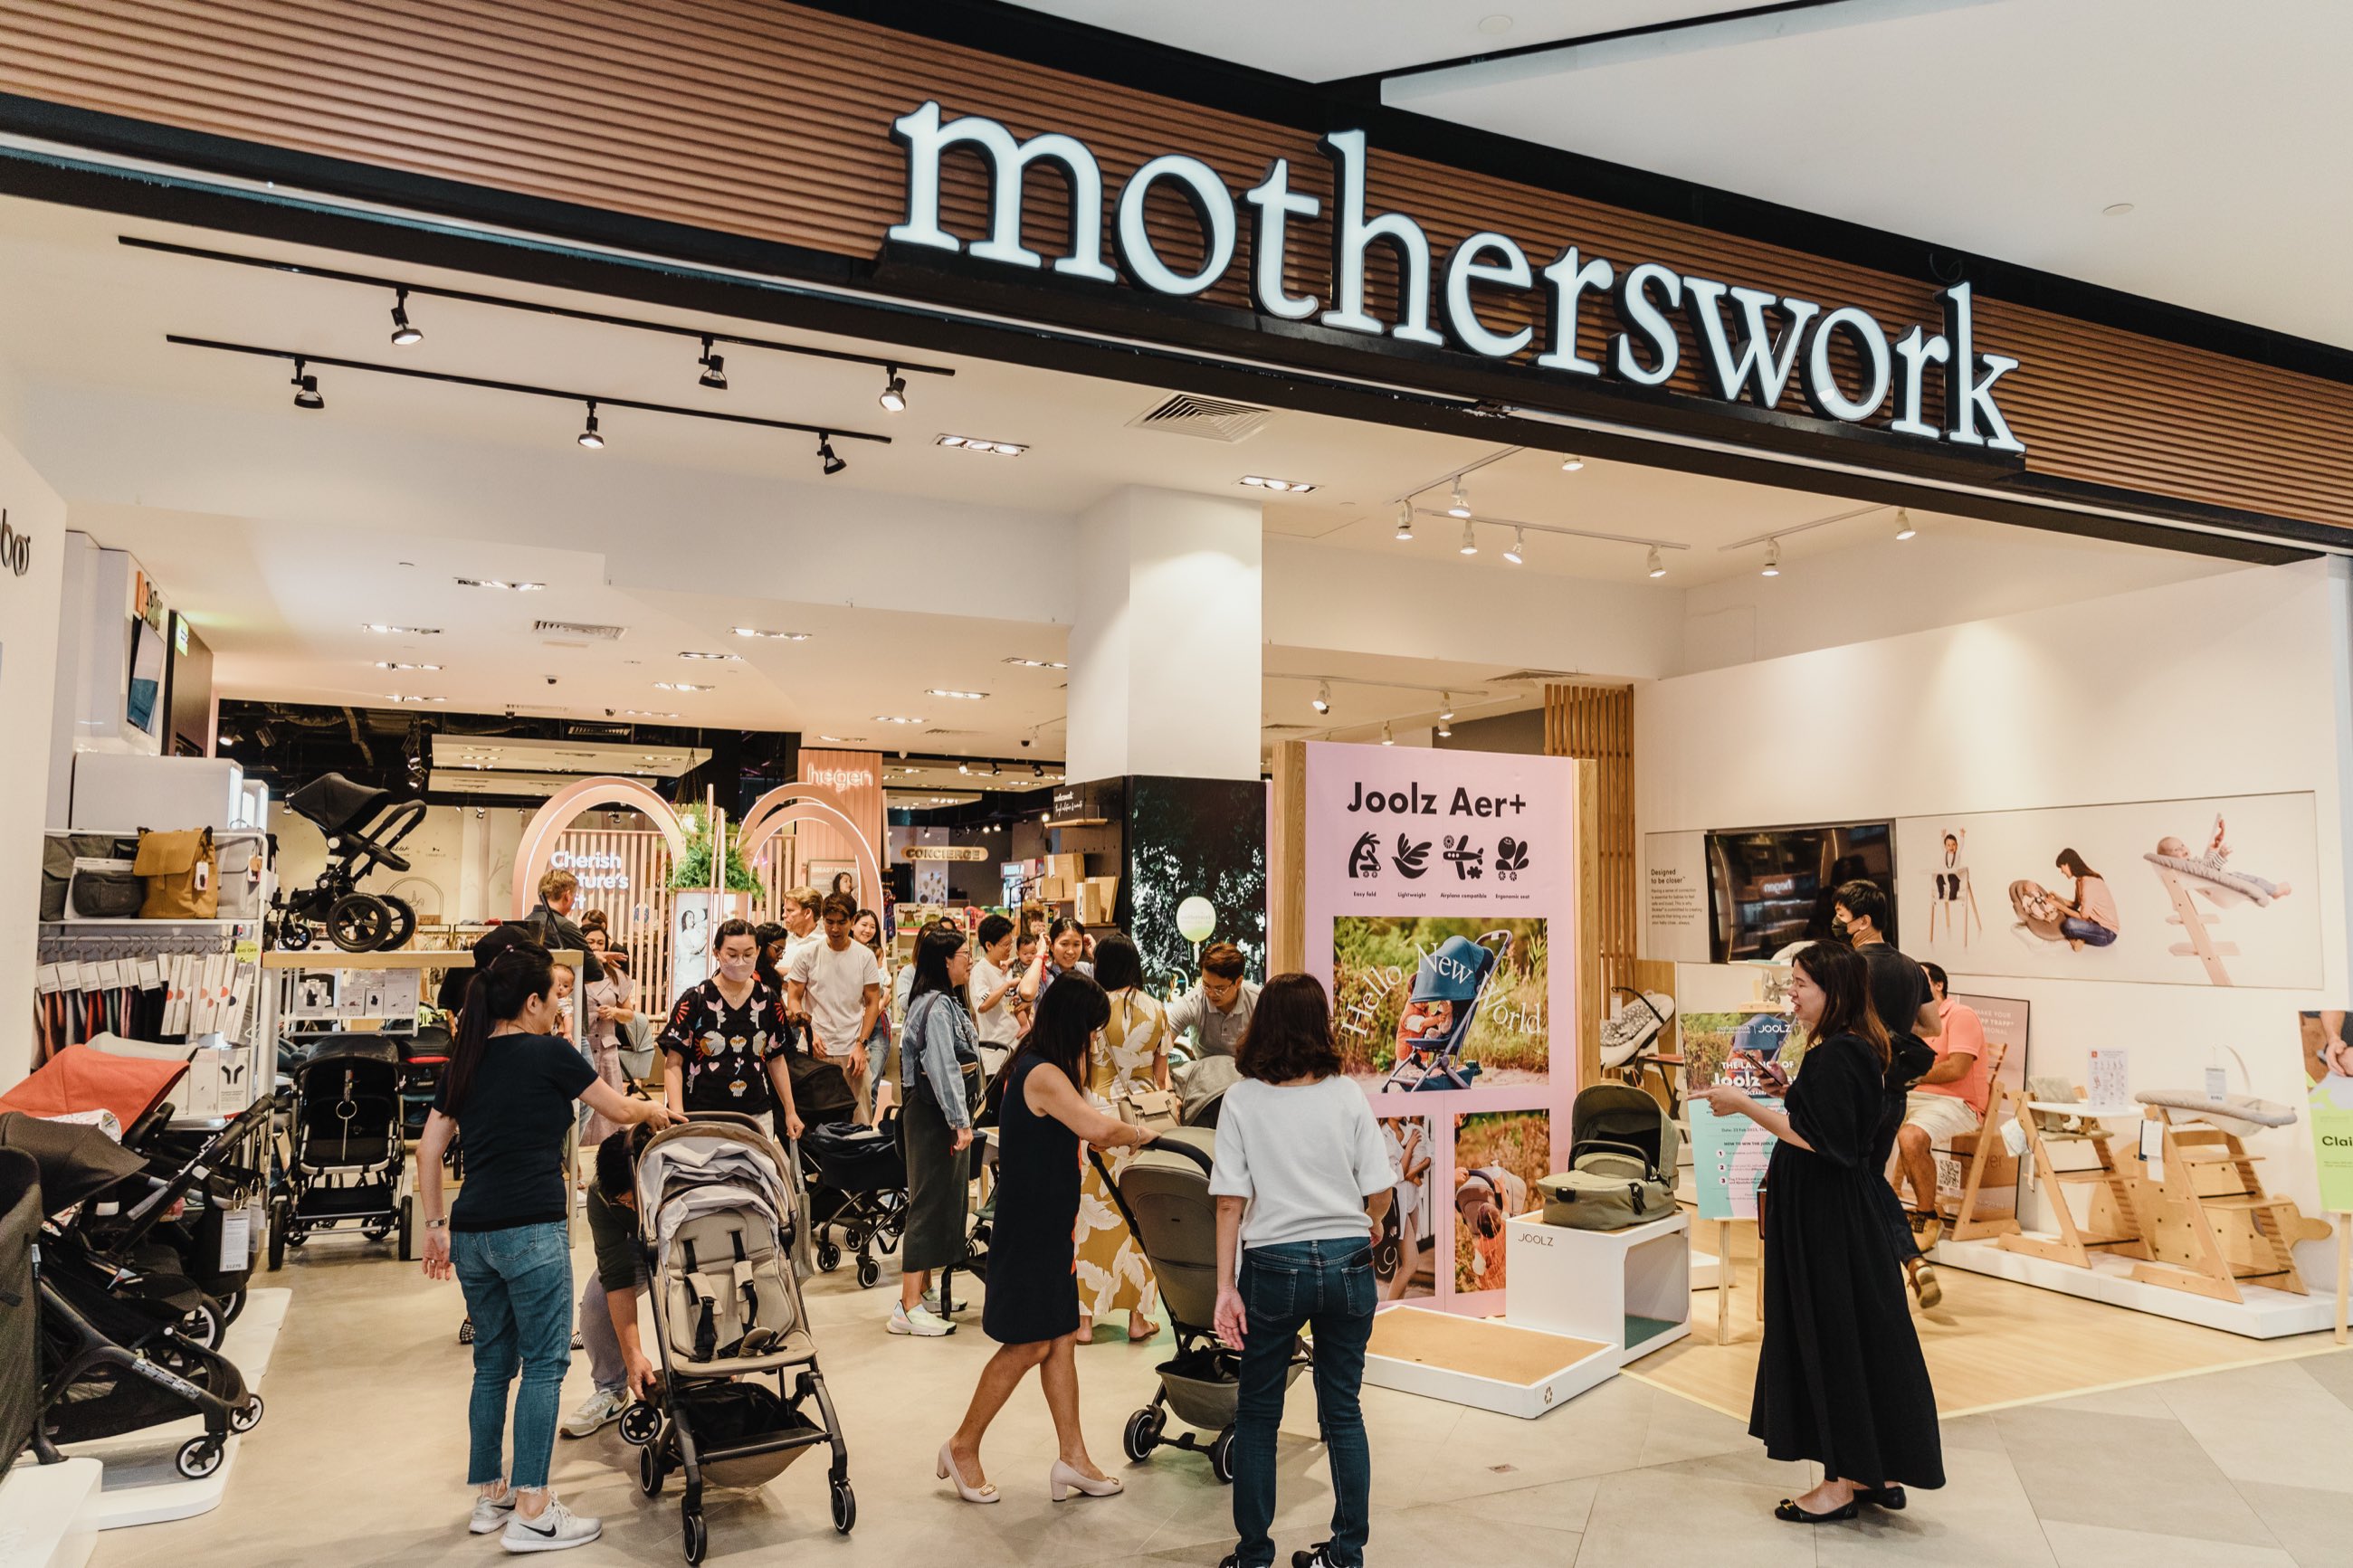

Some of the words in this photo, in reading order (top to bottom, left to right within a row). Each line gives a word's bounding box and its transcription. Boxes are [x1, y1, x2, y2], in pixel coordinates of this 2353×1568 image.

[889, 99, 2026, 453] motherswork
[807, 762, 873, 794] hegen
[1347, 782, 1437, 815] Joolz
[1449, 787, 1527, 818] Aer+
[550, 851, 622, 869] Cherish
[905, 849, 980, 860] CONCIERGE
[576, 872, 629, 889] ture's
[1651, 869, 1676, 878] Designed
[1340, 965, 1403, 1038] Hello
[1414, 942, 1473, 984] New
[1475, 970, 1542, 1035] World
[1995, 1011, 2013, 1019] YOUR
[1758, 1024, 1792, 1033] JOOLZ
[1721, 1061, 1741, 1069] THE
[1782, 1060, 1794, 1069] OF
[1518, 1233, 1554, 1247] JOOLZ
